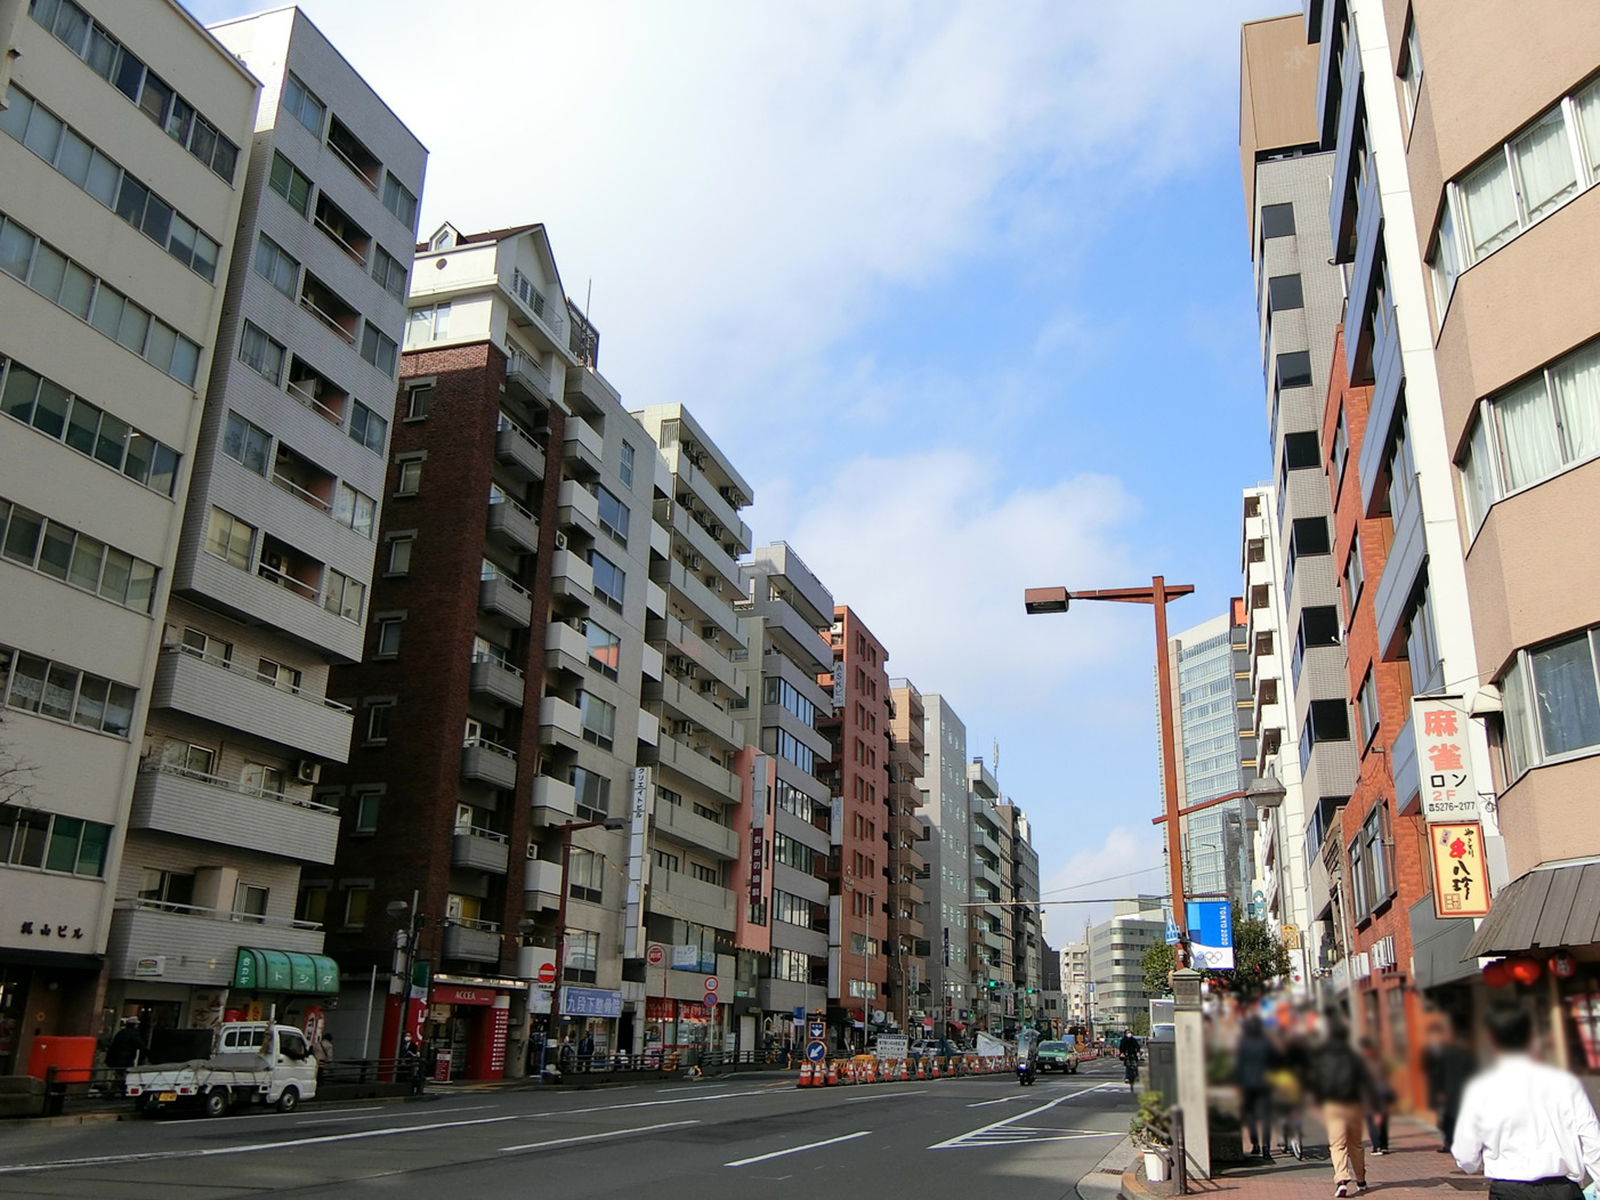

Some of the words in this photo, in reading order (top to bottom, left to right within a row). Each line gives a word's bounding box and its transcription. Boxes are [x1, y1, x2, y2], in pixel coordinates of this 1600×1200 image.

[1424, 709, 1464, 772] 麻雀
[1430, 773, 1467, 788] ロン
[635, 767, 645, 819] クリエイトビル
[1432, 789, 1456, 801] 2F
[1435, 801, 1476, 812] 5276-2177
[1463, 828, 1475, 858] やきとり
[1219, 906, 1228, 928] TOKYO
[1220, 929, 1229, 945] 2020
[240, 957, 251, 985] 合カギ
[275, 971, 333, 985] トシダ
[454, 990, 476, 1000] ACCEA
[566, 994, 621, 1014] 九段下整骨院
